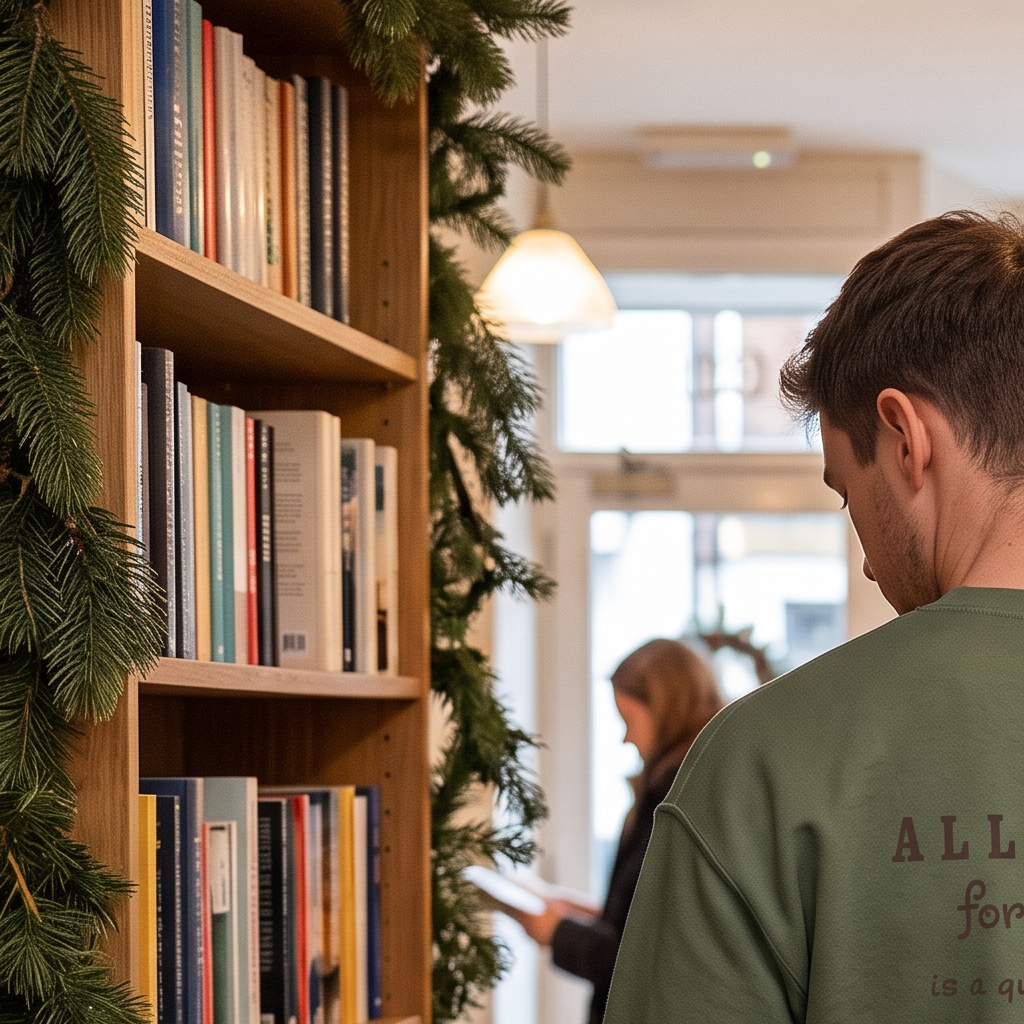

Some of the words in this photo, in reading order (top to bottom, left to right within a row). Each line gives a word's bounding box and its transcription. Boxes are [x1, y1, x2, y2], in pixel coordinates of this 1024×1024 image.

[891, 814, 1016, 863] ALL
[931, 973, 959, 997] is
[969, 977, 988, 997] a
